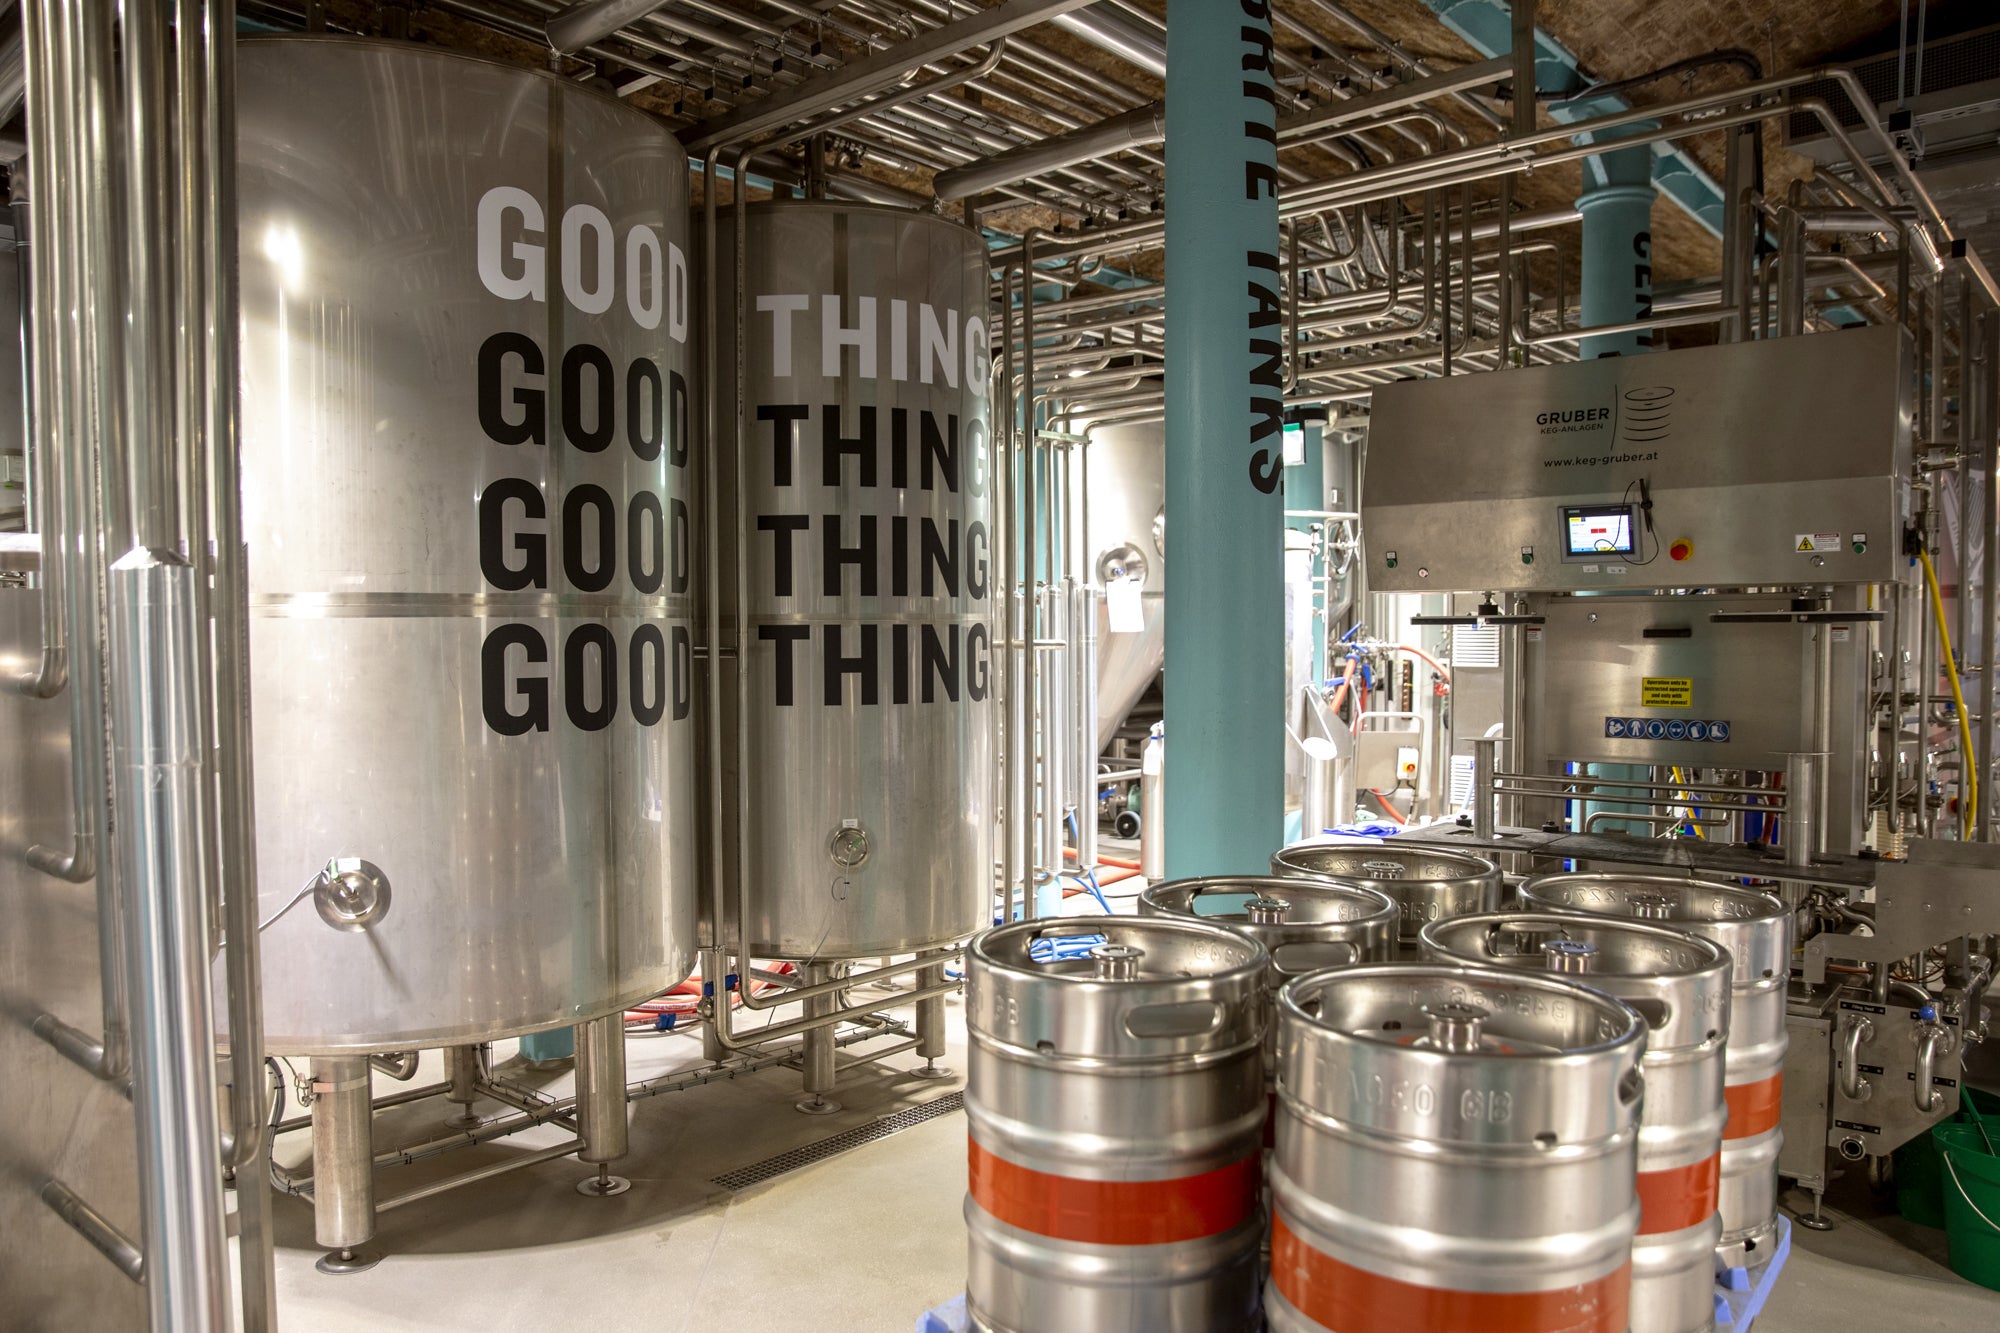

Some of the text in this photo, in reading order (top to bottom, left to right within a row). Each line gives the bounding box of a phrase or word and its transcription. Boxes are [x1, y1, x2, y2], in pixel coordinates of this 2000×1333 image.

[477, 186, 992, 397] GOOD THING
[477, 332, 990, 498] GOOD THING
[1536, 407, 1610, 425] GRUBER
[1540, 423, 1604, 434] KEG-ANLAGEN
[1544, 452, 1659, 467] www.keg-gruber.at
[478, 477, 992, 600] GOOD THING
[481, 623, 993, 736] GOOD THING
